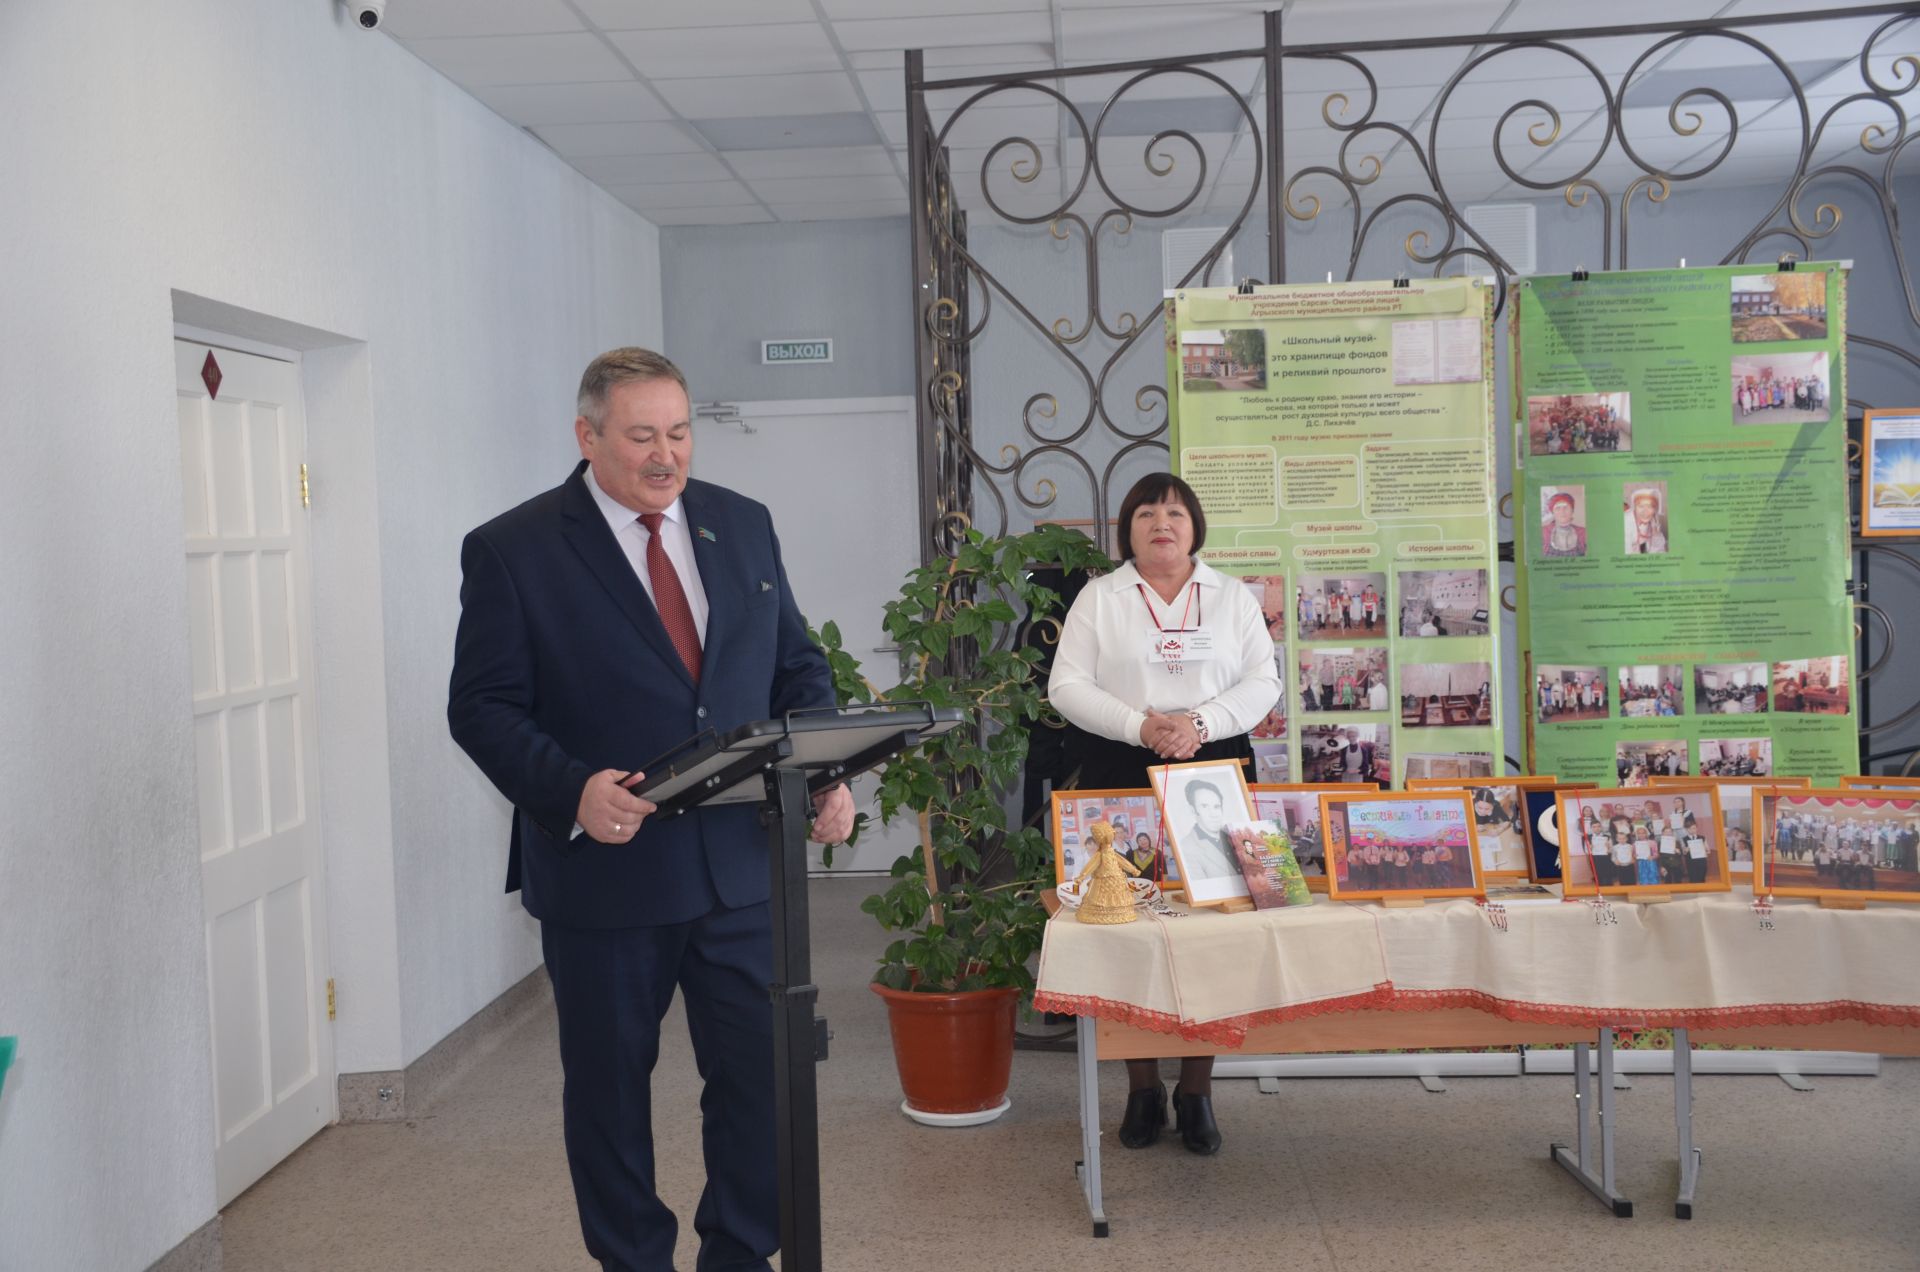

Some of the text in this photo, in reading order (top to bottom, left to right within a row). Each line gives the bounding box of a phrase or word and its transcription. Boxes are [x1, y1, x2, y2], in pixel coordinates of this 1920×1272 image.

[1229, 288, 1424, 302] Муниципальное бюджетное общеобразовательное
[1254, 300, 1298, 309] учреждение
[1332, 296, 1374, 305] Омгинский
[1376, 296, 1400, 304] лицей
[1251, 307, 1295, 316] Агрызского
[1297, 305, 1361, 315] муниципального
[1363, 304, 1390, 313] района
[1282, 334, 1376, 345] «Школьный музей-
[768, 344, 826, 359] ВЫХОД
[1272, 350, 1388, 362] это хранилище фондов
[1273, 366, 1386, 378] и реликвий прошлого»
[1282, 396, 1315, 404] родному
[1384, 392, 1416, 400] истории
[1308, 402, 1339, 410] которой
[1216, 413, 1278, 422] осуществляться
[1282, 412, 1300, 421] рост
[1301, 410, 1339, 420] духовной
[1340, 410, 1377, 418] культуры
[1402, 406, 1440, 415] общества
[1306, 420, 1322, 428] Д.С.
[1294, 434, 1308, 442] году
[1307, 524, 1362, 533] Музей школы
[1218, 550, 1248, 558] боевой
[1302, 546, 1372, 557] Удмуртская изба
[1408, 544, 1474, 553] История школы
